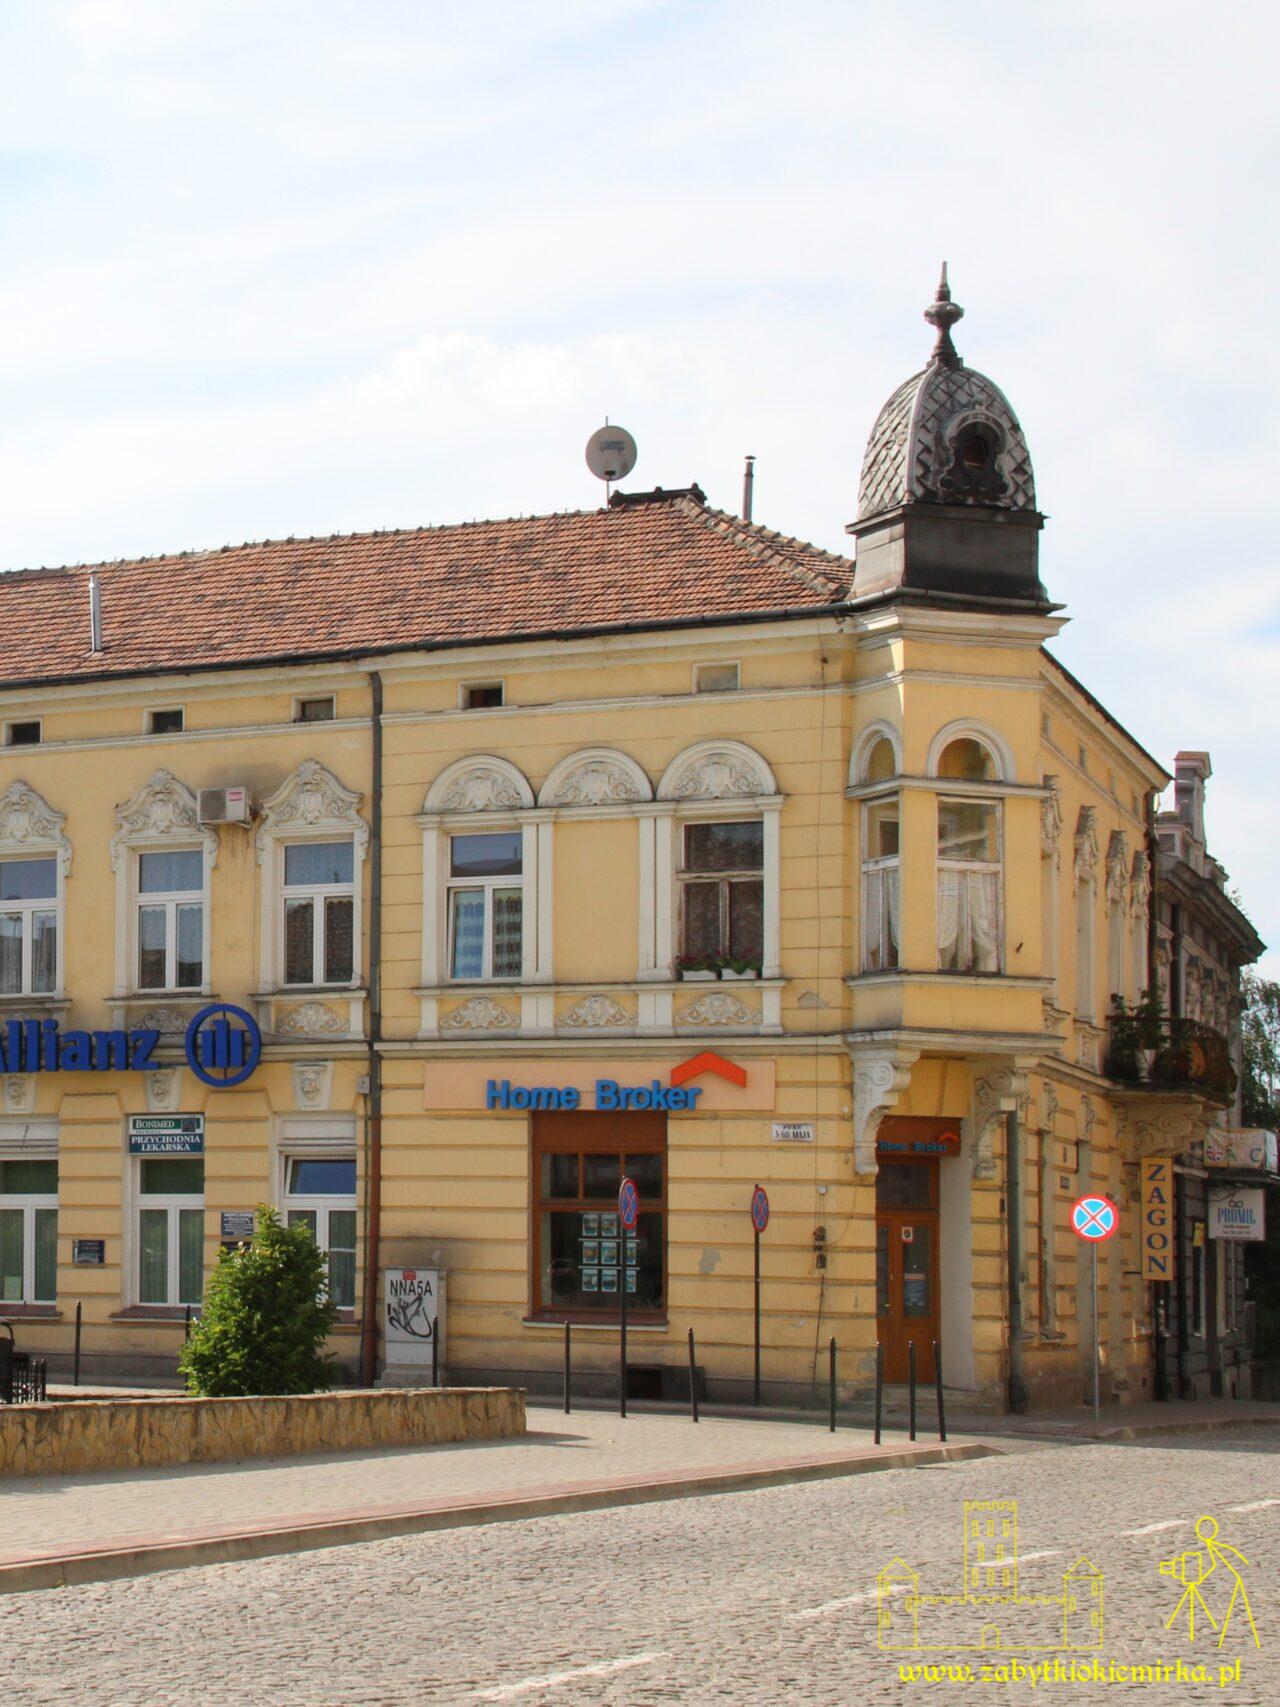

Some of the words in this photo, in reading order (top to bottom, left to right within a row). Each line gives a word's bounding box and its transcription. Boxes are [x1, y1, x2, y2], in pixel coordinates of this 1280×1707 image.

[487, 1080, 580, 1109] Home
[595, 1080, 703, 1110] Broker
[131, 1135, 200, 1144] PRZYCHODNIA
[141, 1143, 191, 1152] LEKARSKA
[1147, 1163, 1169, 1273] ZAGON
